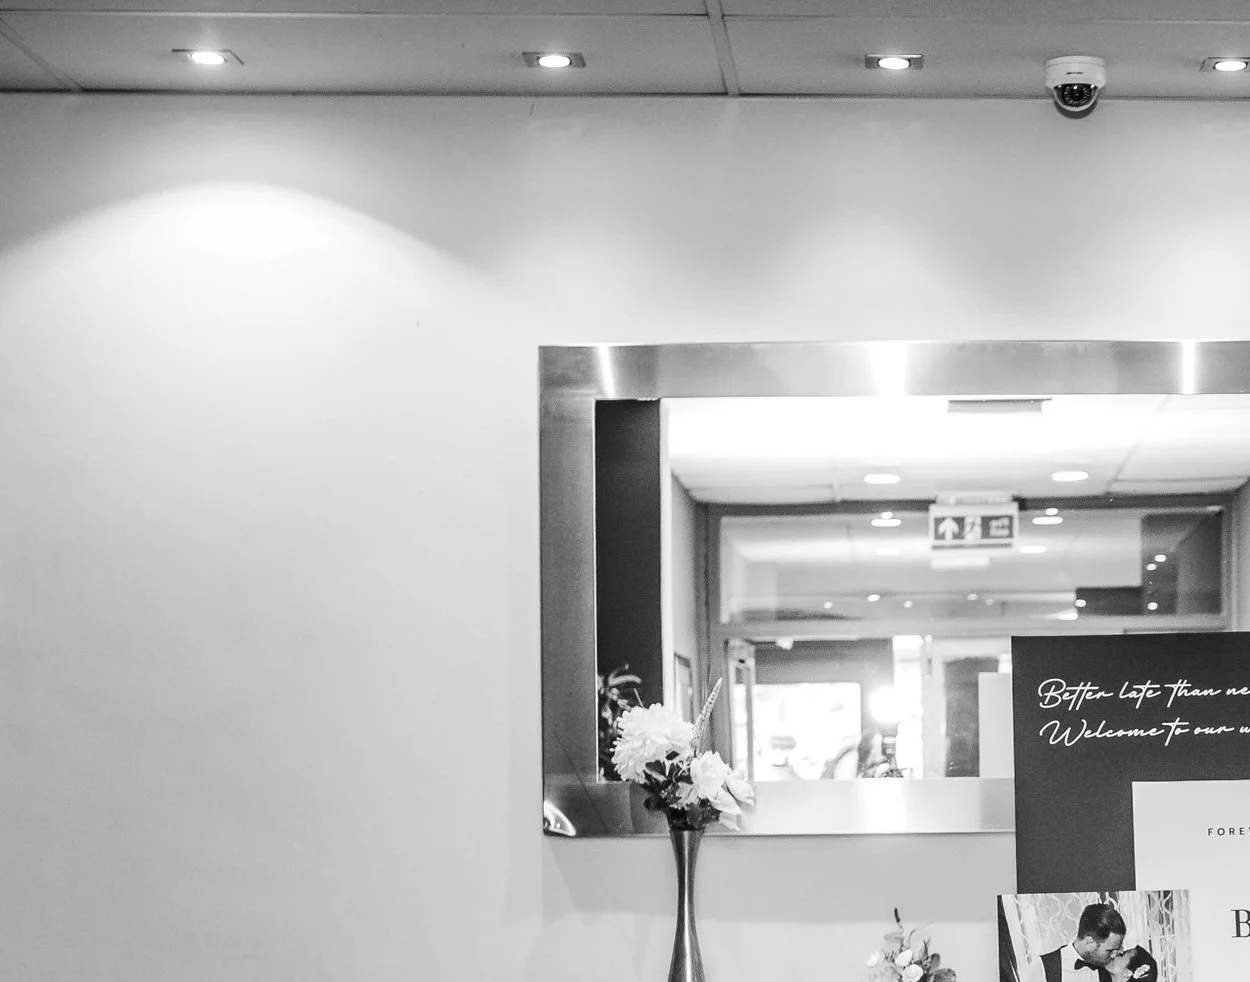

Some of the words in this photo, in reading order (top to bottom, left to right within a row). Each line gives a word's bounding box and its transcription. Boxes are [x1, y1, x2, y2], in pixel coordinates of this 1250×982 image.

[1038, 678, 1114, 711] Better
[1119, 680, 1162, 709] late
[1164, 679, 1222, 708] than
[1039, 719, 1165, 747] Welcome
[1162, 717, 1190, 747] to
[1194, 725, 1235, 735] our
